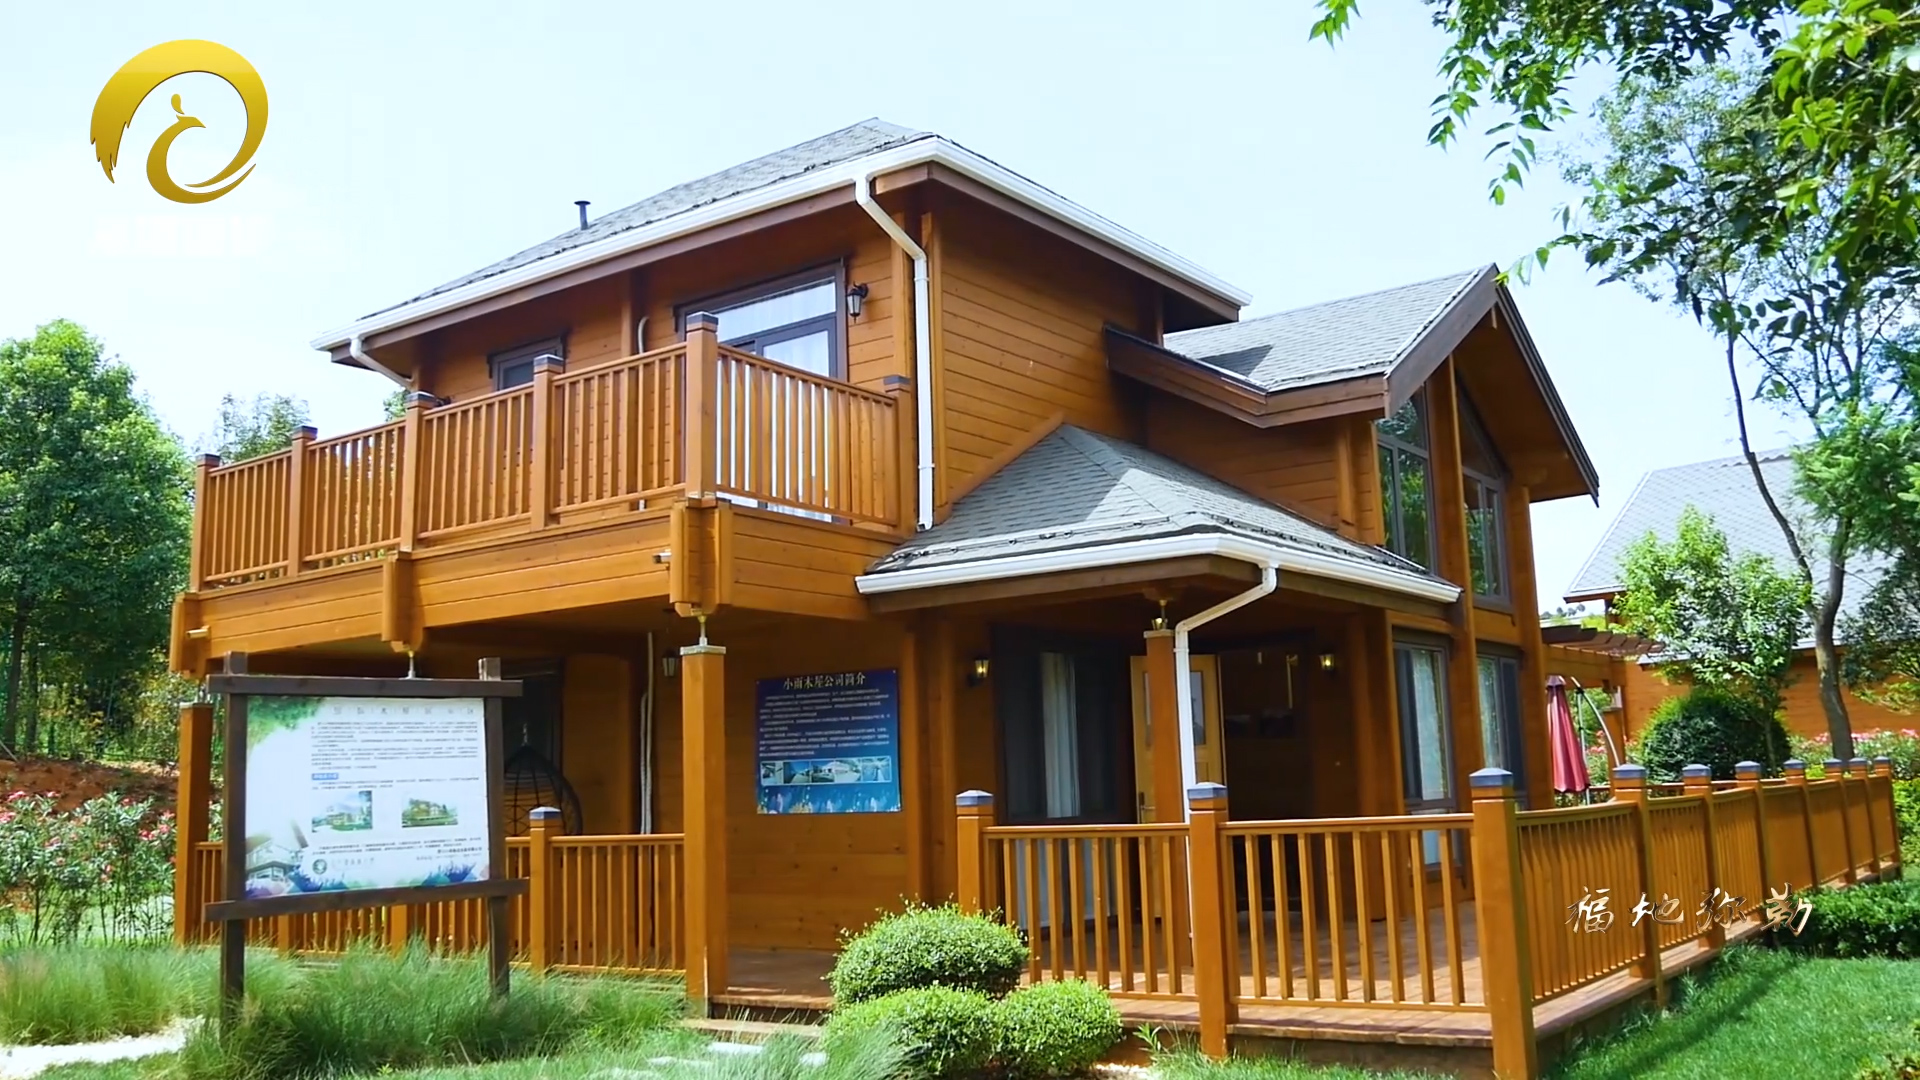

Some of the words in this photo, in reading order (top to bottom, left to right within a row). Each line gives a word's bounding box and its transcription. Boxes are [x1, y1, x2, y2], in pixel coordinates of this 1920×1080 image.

[783, 671, 866, 690] 小雨木屋公司简介
